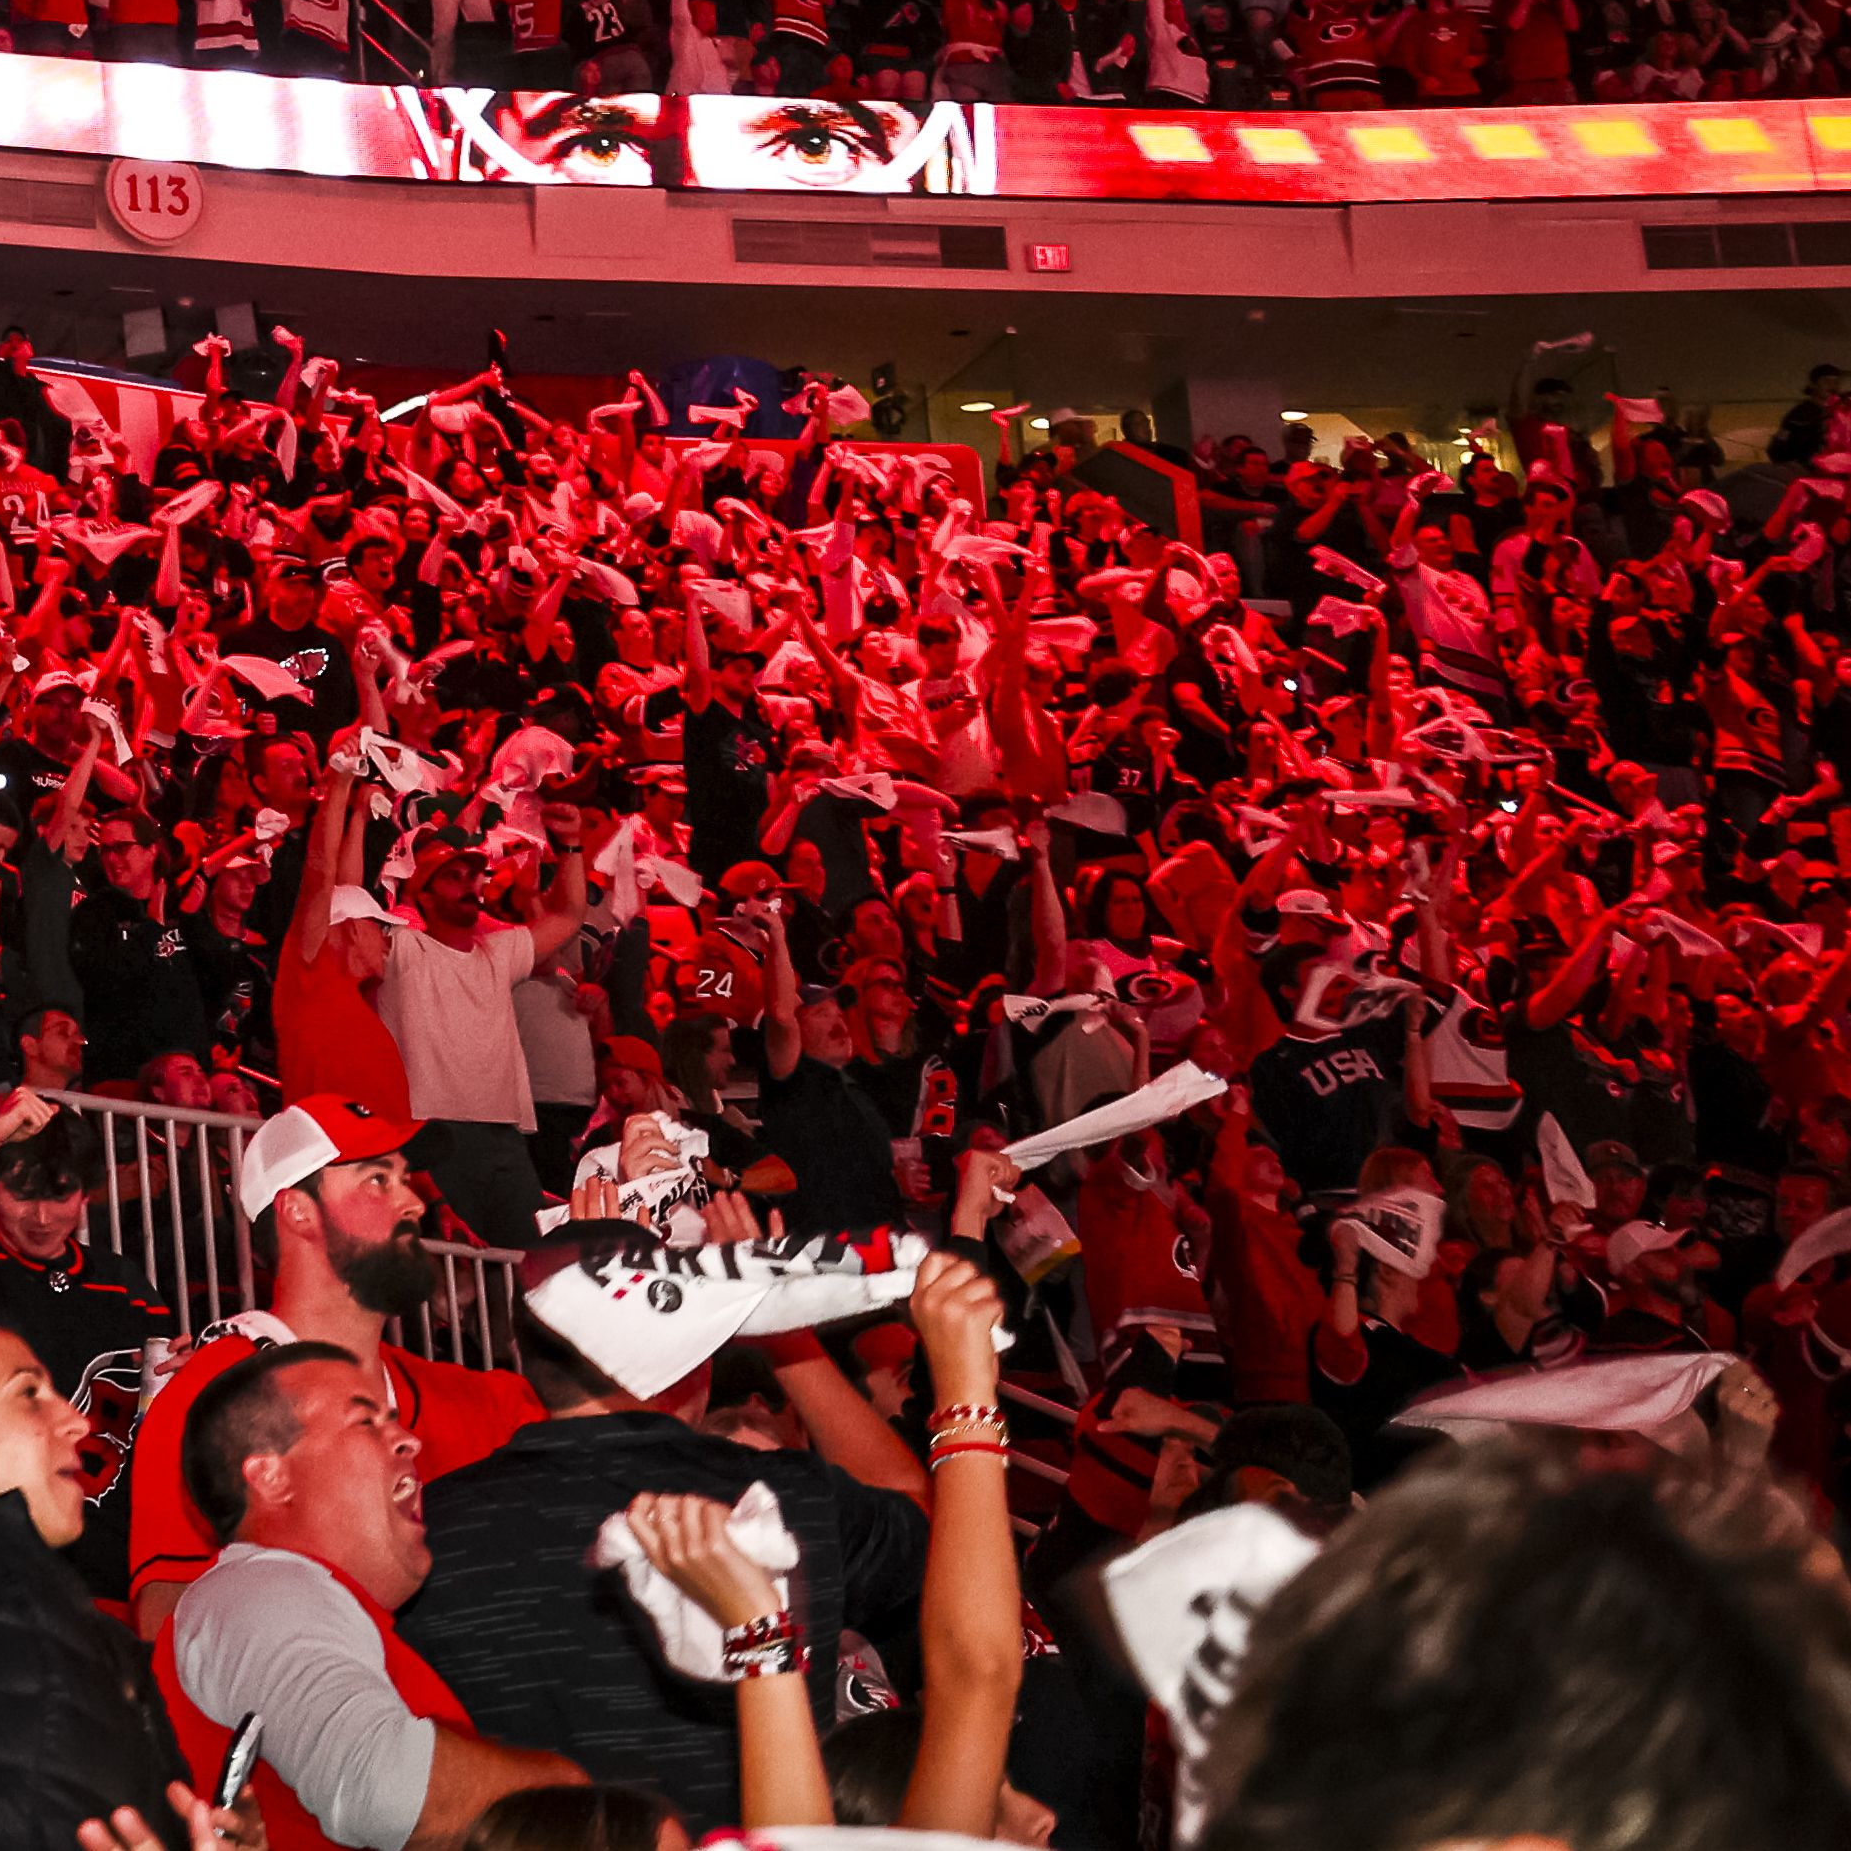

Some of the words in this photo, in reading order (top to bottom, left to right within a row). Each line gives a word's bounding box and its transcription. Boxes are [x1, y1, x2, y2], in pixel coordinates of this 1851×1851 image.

[510, 1, 536, 39] 5
[583, 1, 625, 43] 23
[126, 174, 190, 216] 113
[1118, 767, 1143, 788] 37
[695, 969, 734, 999] 24
[1300, 1047, 1385, 1097] USA
